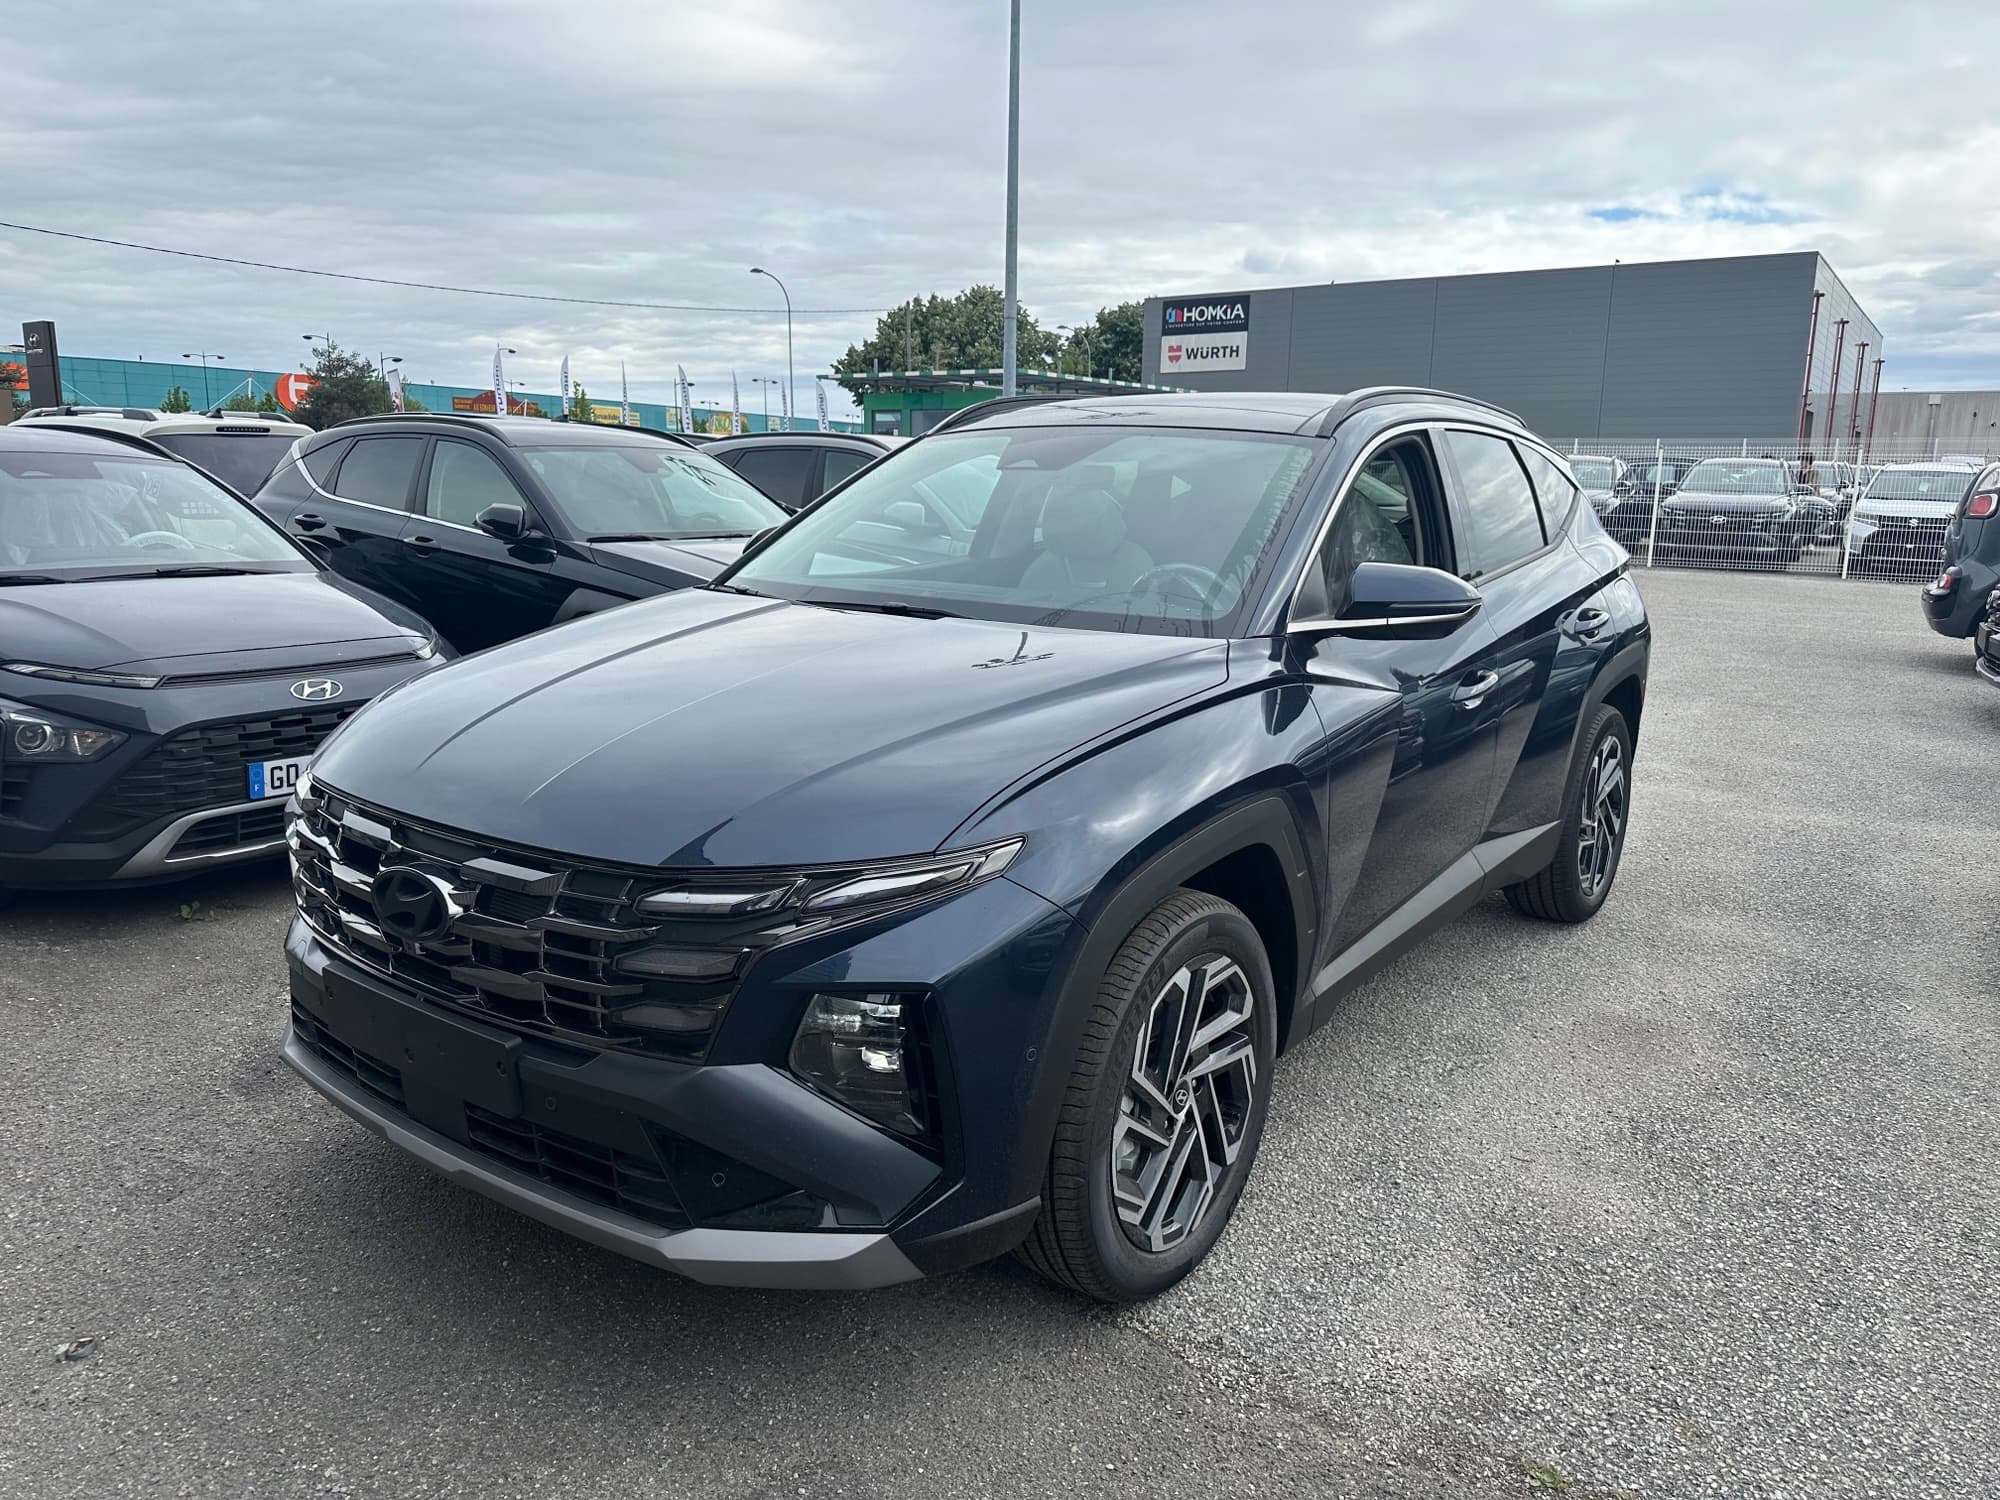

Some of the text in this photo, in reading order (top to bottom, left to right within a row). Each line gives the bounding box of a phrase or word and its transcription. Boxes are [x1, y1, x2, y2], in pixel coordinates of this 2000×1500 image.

[1185, 345, 1240, 360] WÜRTH
[271, 764, 299, 789] GD
[255, 784, 260, 792] F
